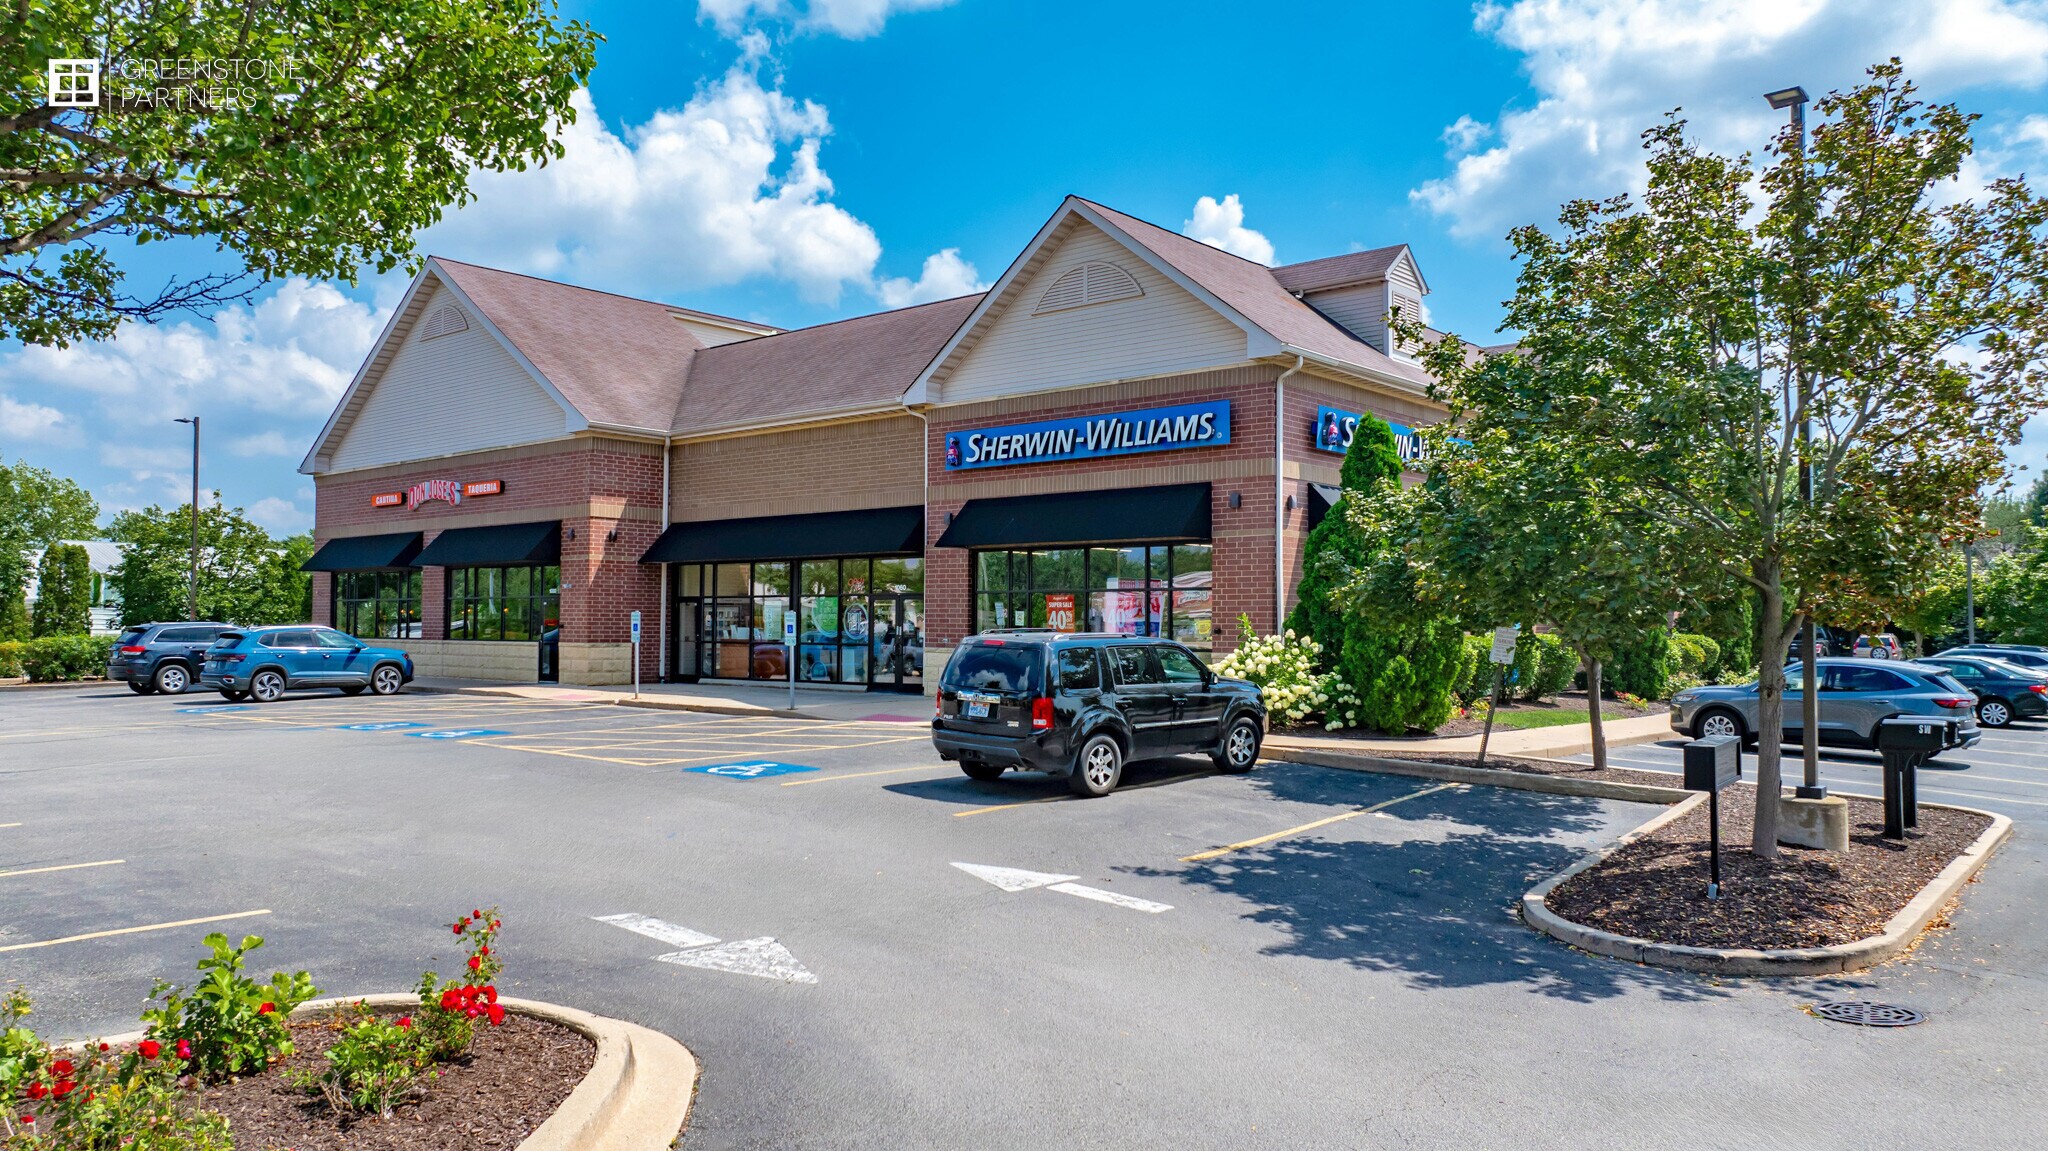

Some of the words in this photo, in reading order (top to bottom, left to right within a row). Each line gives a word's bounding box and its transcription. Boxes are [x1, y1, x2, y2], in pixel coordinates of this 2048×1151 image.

[965, 412, 1213, 463] SHERWIN-WILLIAMS
[408, 482, 426, 510] DON
[468, 483, 496, 493] TAQUERIA
[1919, 725, 1931, 734] SW
